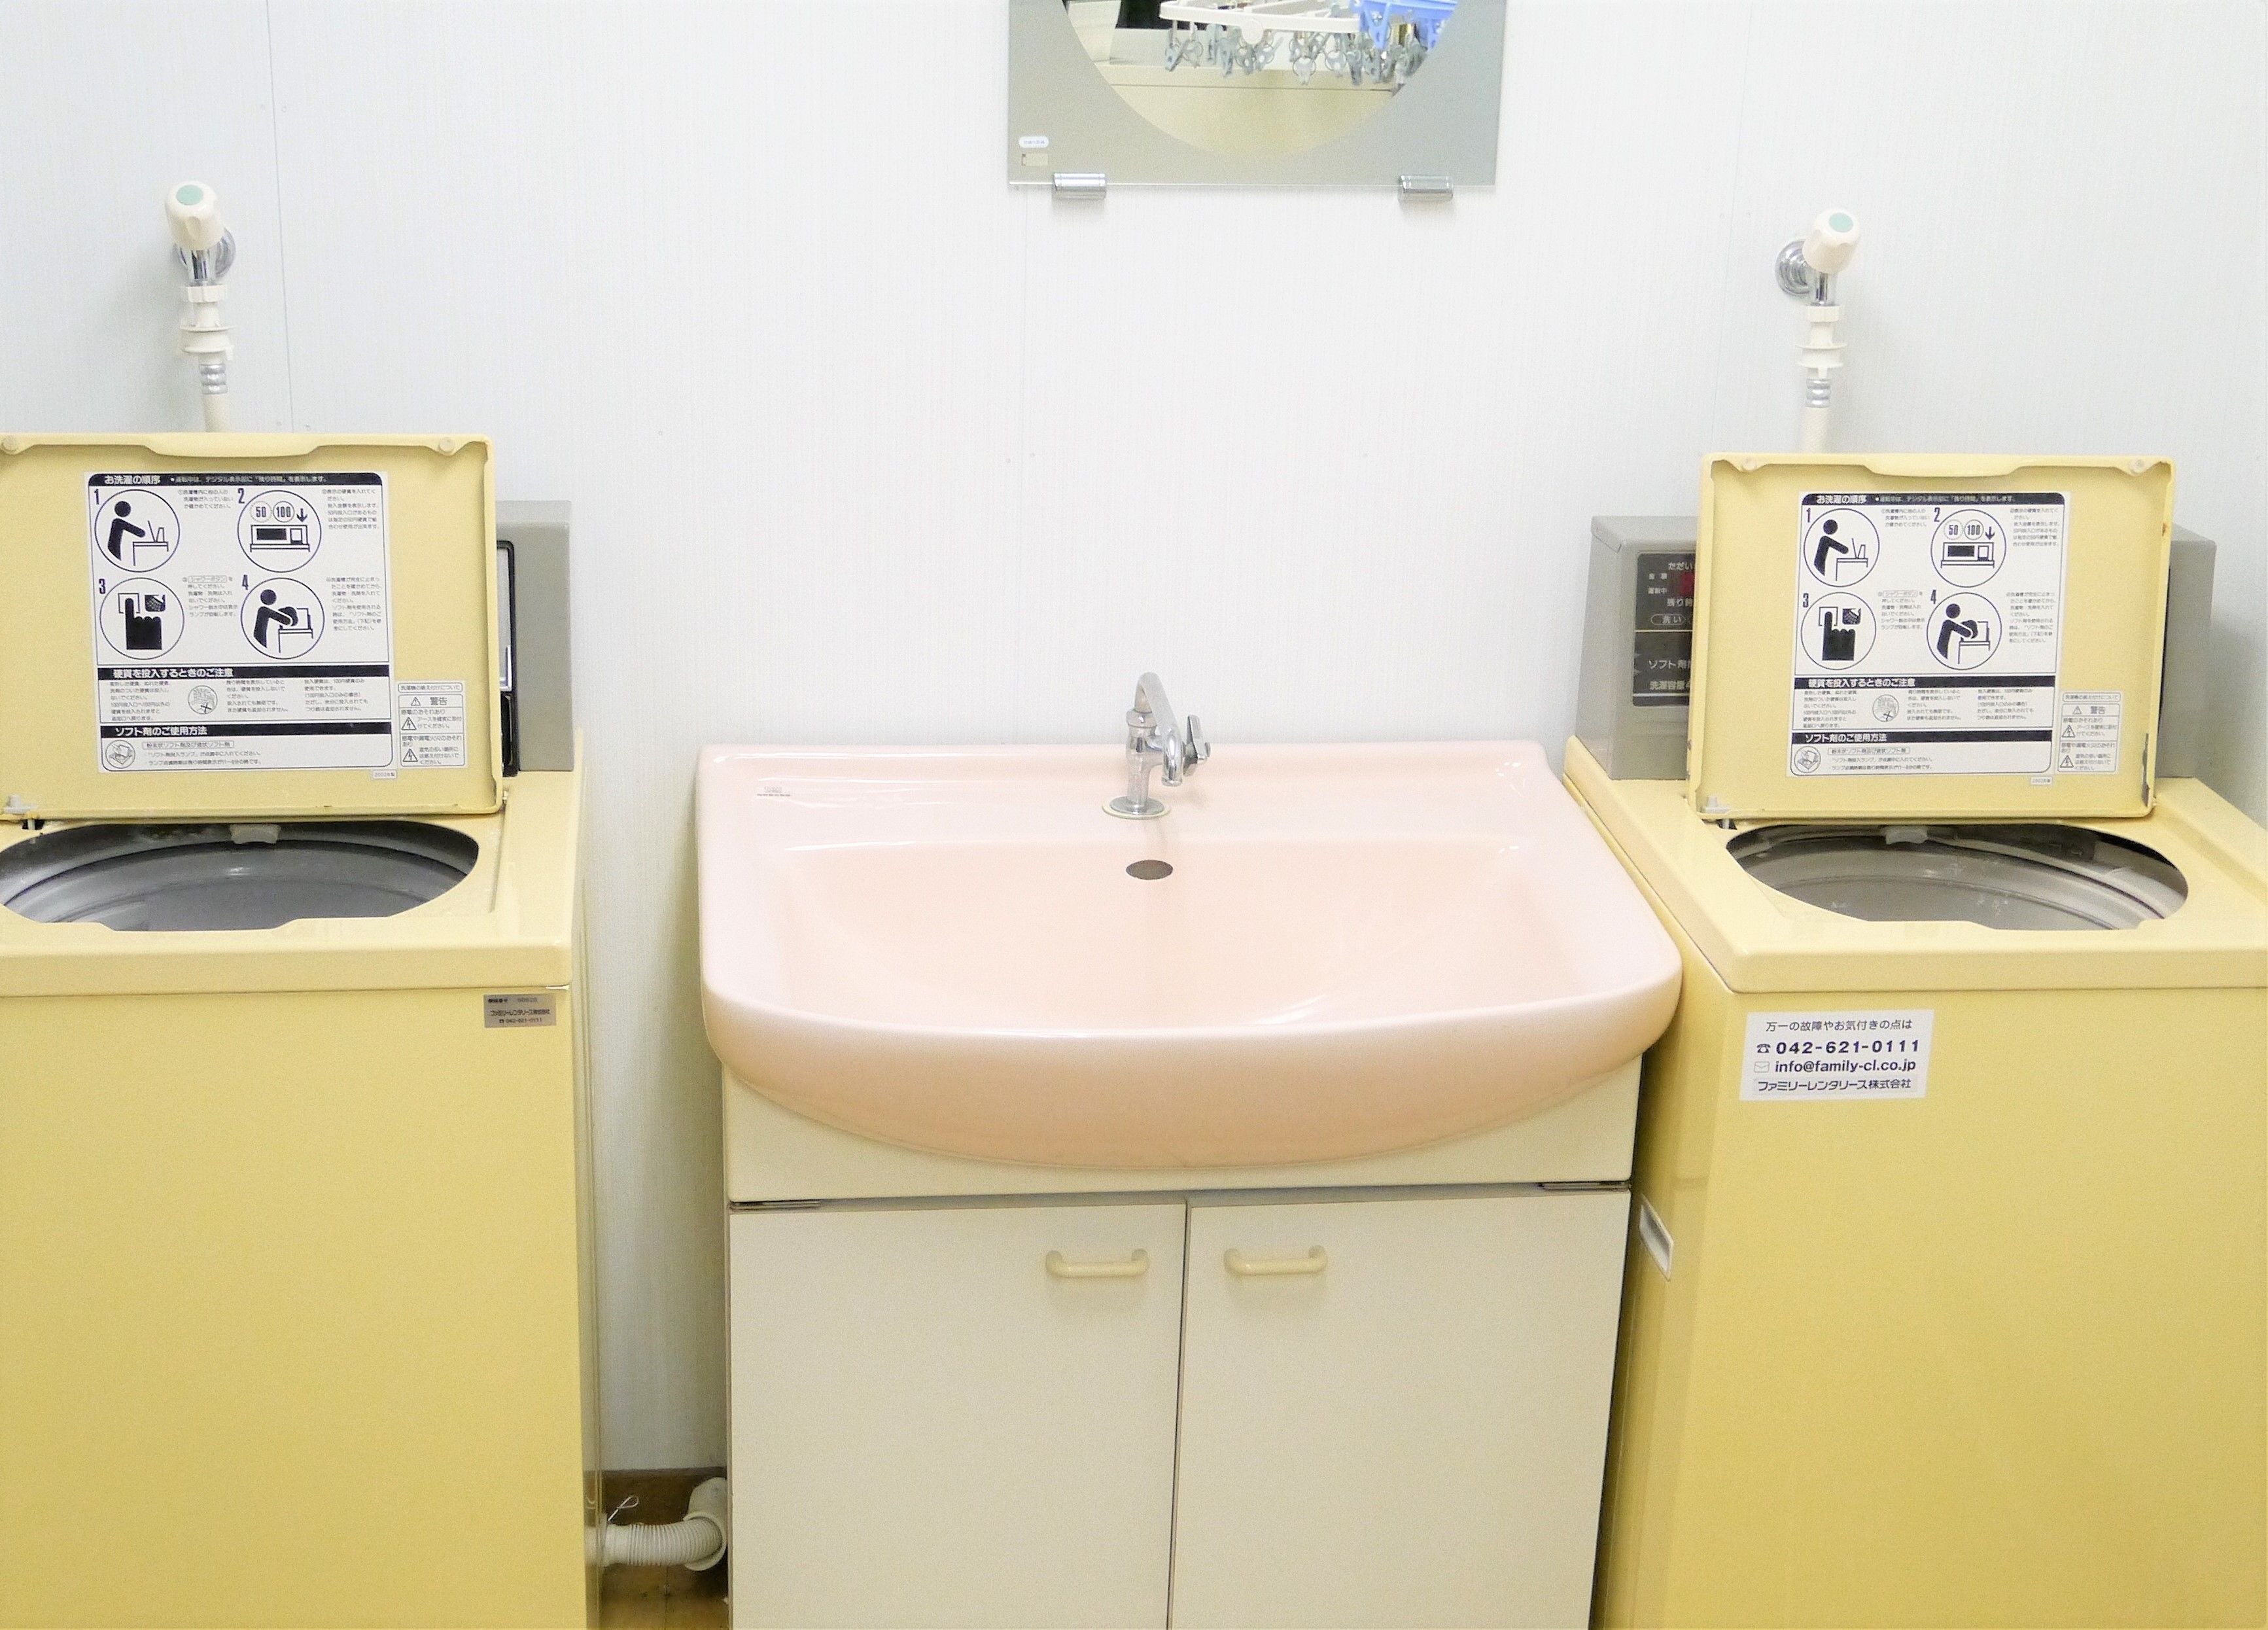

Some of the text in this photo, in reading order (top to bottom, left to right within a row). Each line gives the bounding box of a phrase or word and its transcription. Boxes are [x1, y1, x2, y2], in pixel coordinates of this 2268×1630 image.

[104, 475, 161, 485] お洗濯の順序
[94, 489, 99, 505] 1
[237, 487, 245, 504] 2
[1816, 495, 1867, 504] お洗濯の順序
[256, 506, 292, 518] 50 100
[1807, 508, 1811, 523] 1
[1934, 507, 1940, 522] 2
[1949, 525, 1980, 535] 50 100
[99, 578, 106, 594] 3
[242, 575, 249, 590] 4
[1802, 593, 1809, 608] 3
[1930, 590, 1936, 605] 4
[113, 668, 234, 679] 硬貨を投入するときのご注意
[1808, 679, 1915, 688] 硬貨を投入するときのご注意
[115, 726, 208, 736] ソフト剤のご使用方法
[1806, 734, 1887, 743] ソフト剤のご使用方法
[1766, 1019, 1913, 1032] 万一の故障やお気付きの点は
[1775, 1040, 1919, 1055] 042-621-0111
[1775, 1059, 1916, 1072] info@family-cl.co.jp
[1758, 1078, 1911, 1091] ファミリーレンタリース株式会社
